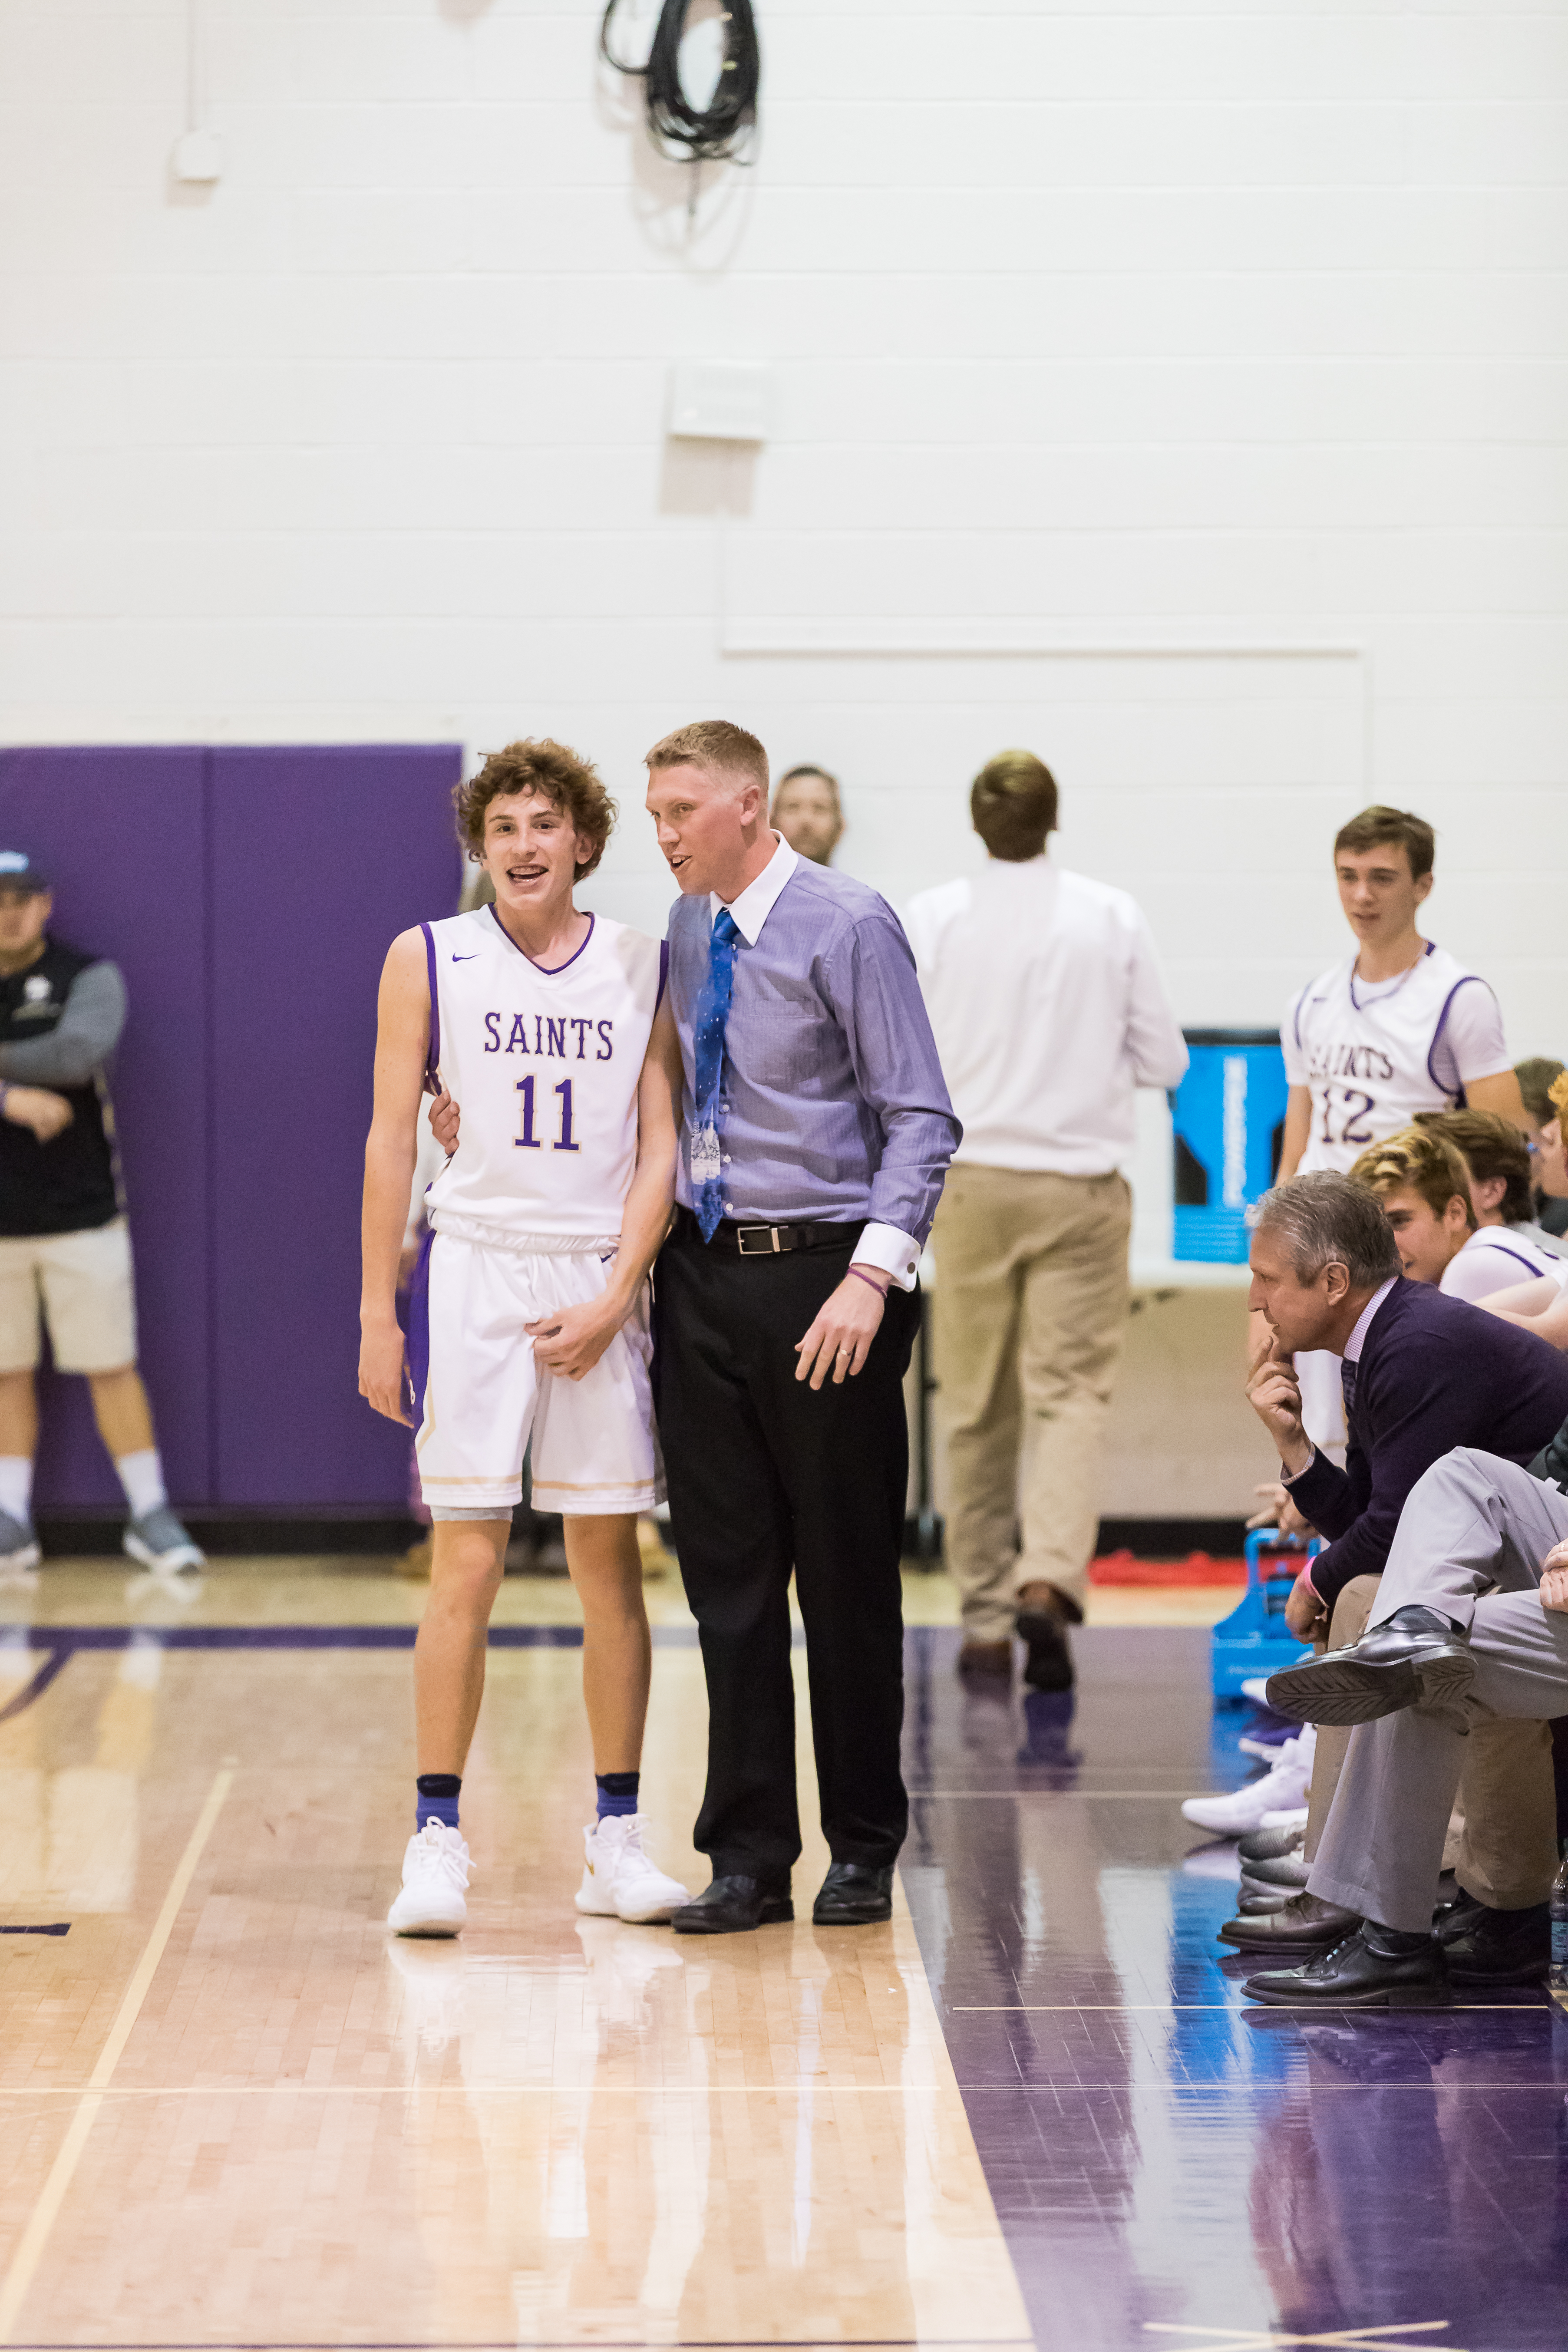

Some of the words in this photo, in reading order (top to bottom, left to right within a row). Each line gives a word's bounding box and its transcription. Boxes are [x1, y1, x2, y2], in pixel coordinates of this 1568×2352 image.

[483, 1011, 613, 1061] SAINTS
[514, 1073, 581, 1153] 11
[1321, 1088, 1375, 1144] 12
